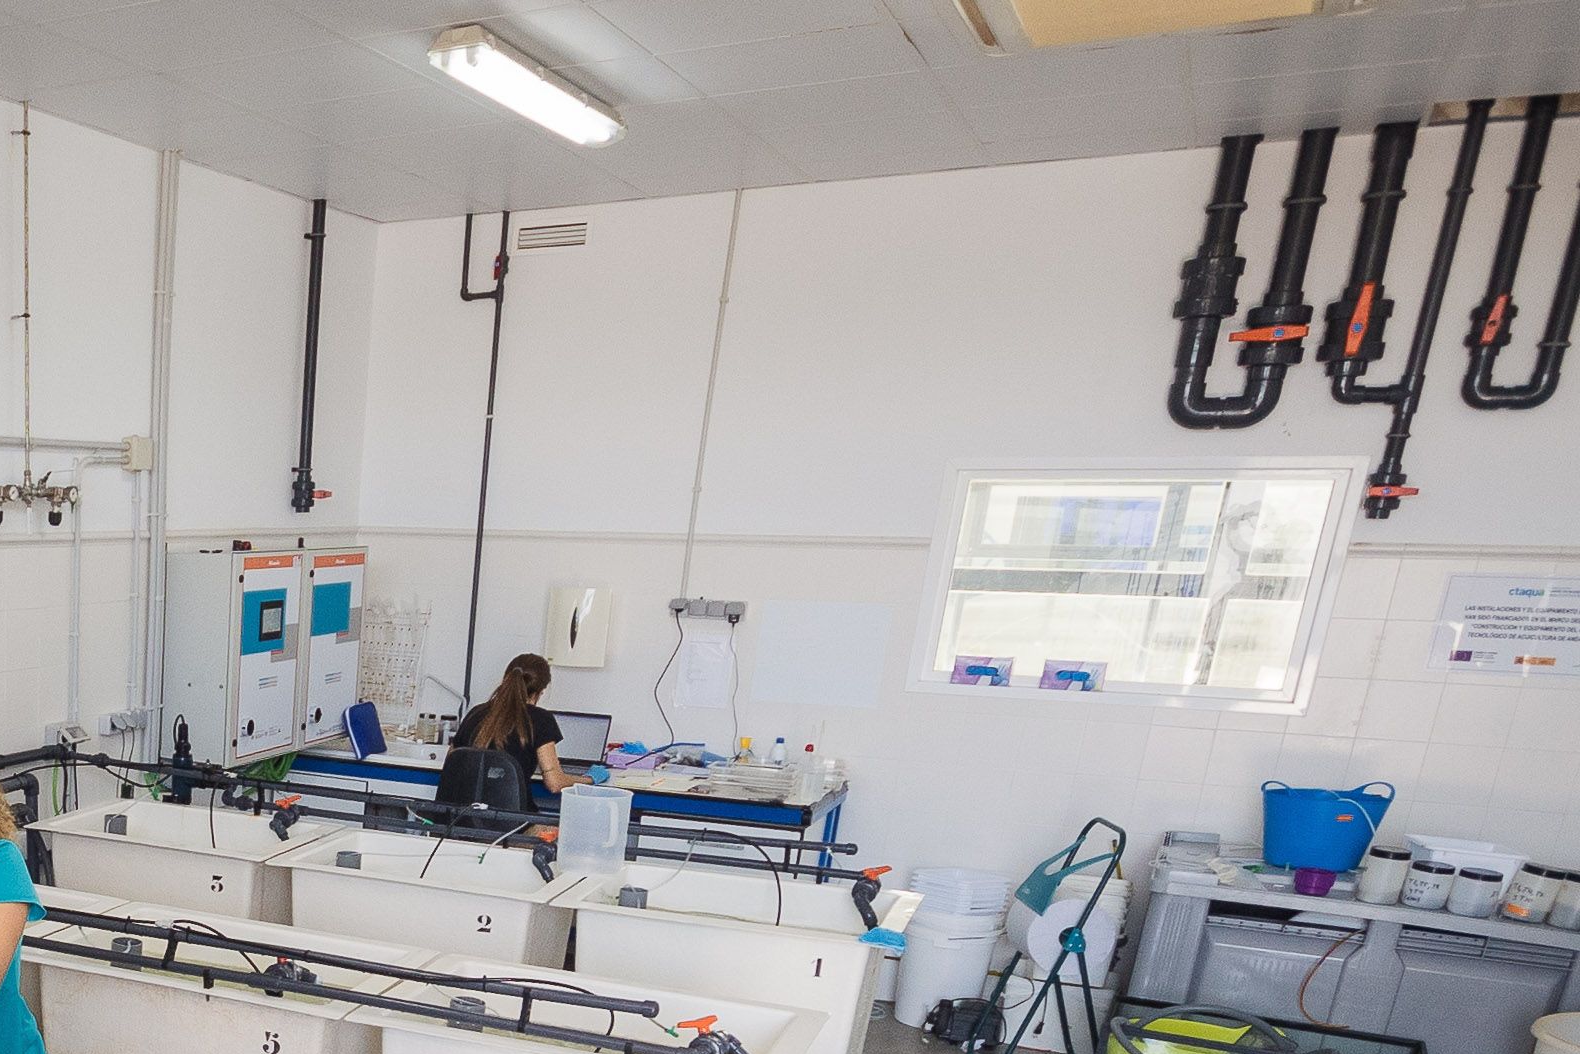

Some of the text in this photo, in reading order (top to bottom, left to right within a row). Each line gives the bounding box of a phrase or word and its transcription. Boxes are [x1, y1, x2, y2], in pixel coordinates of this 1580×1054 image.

[1508, 587, 1545, 599] ctaqua
[476, 914, 492, 934] 2
[813, 957, 823, 978] 1
[262, 1030, 281, 1054] 5
